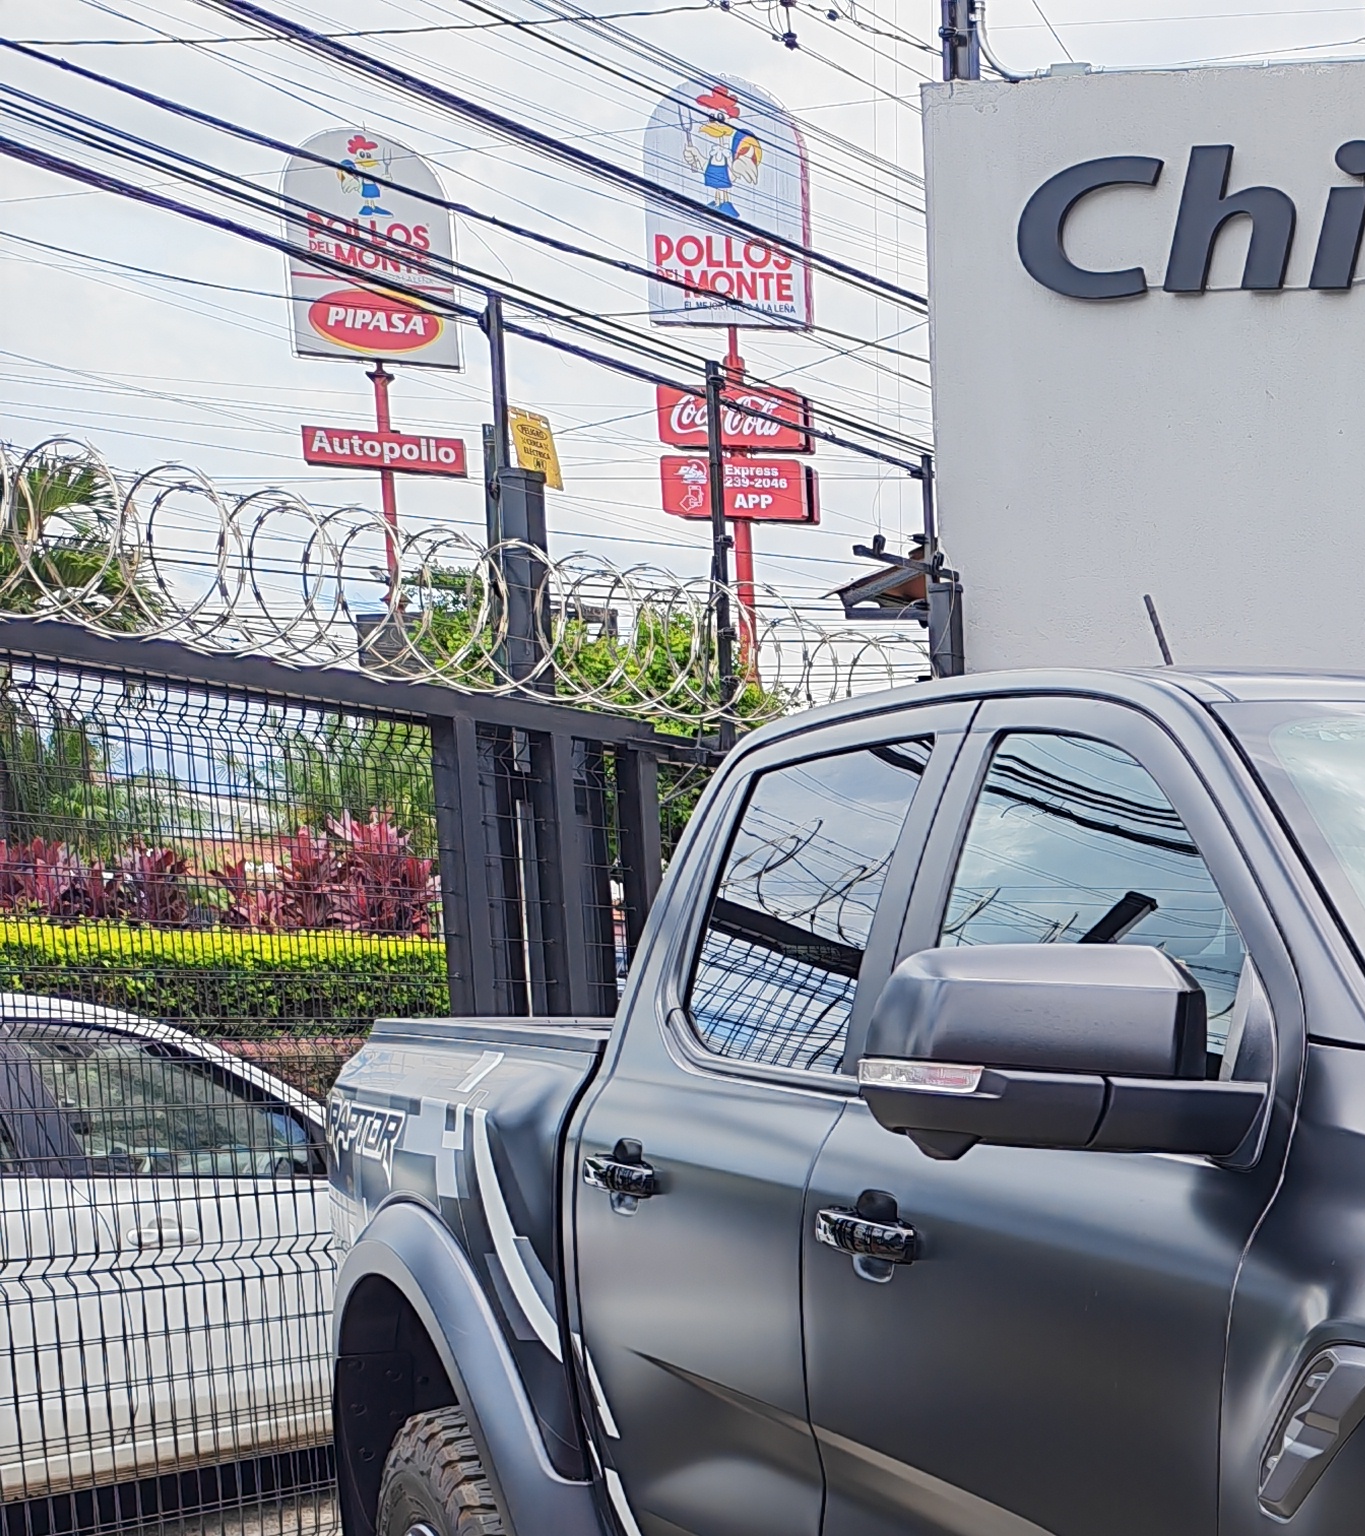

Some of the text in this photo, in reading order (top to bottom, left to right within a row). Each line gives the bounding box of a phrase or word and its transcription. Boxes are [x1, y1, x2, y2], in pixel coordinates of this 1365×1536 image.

[309, 240, 431, 275] DEL MON
[654, 233, 792, 271] POLLOS
[684, 269, 794, 302] MONTE
[327, 306, 425, 336] PIPASA
[670, 394, 783, 436] CocCola
[311, 430, 456, 464] Autopollo
[724, 463, 779, 478] Express
[734, 493, 773, 509] APP
[329, 1096, 407, 1191] RAPTOR
